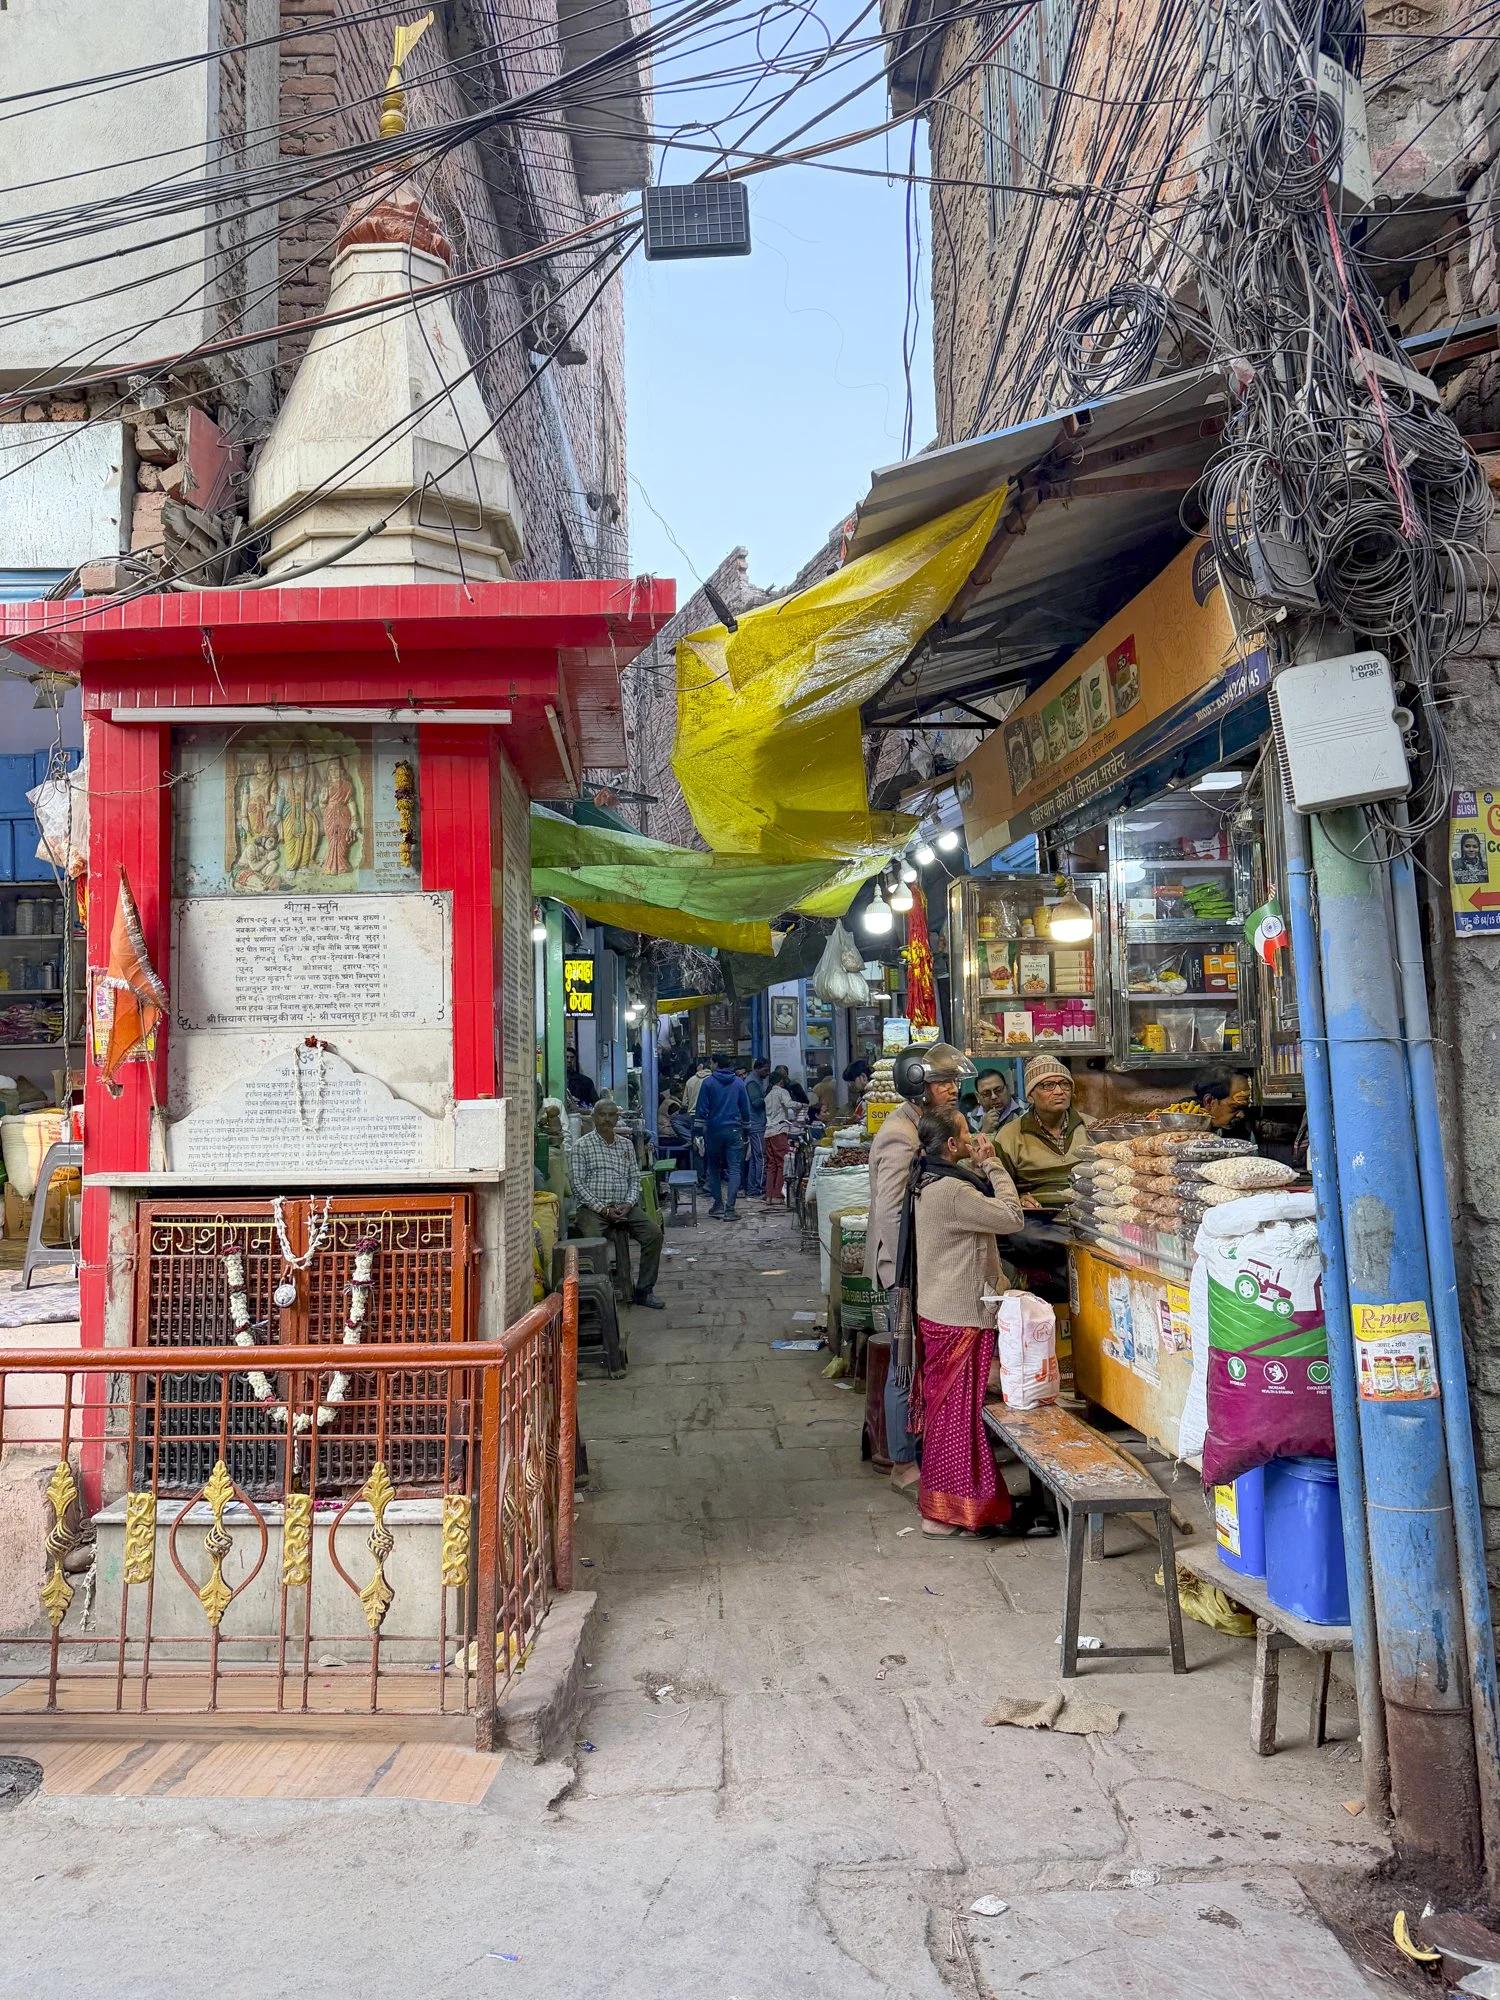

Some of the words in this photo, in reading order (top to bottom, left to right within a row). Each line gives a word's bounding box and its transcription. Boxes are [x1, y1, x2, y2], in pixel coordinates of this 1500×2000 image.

[1351, 661, 1378, 673] home
[1359, 668, 1382, 677] brain
[206, 1013, 217, 1024] श्री
[290, 1013, 304, 1021] जय
[319, 1010, 330, 1021] श्री
[401, 1011, 416, 1019] जय
[1361, 1308, 1420, 1329] R-pure
